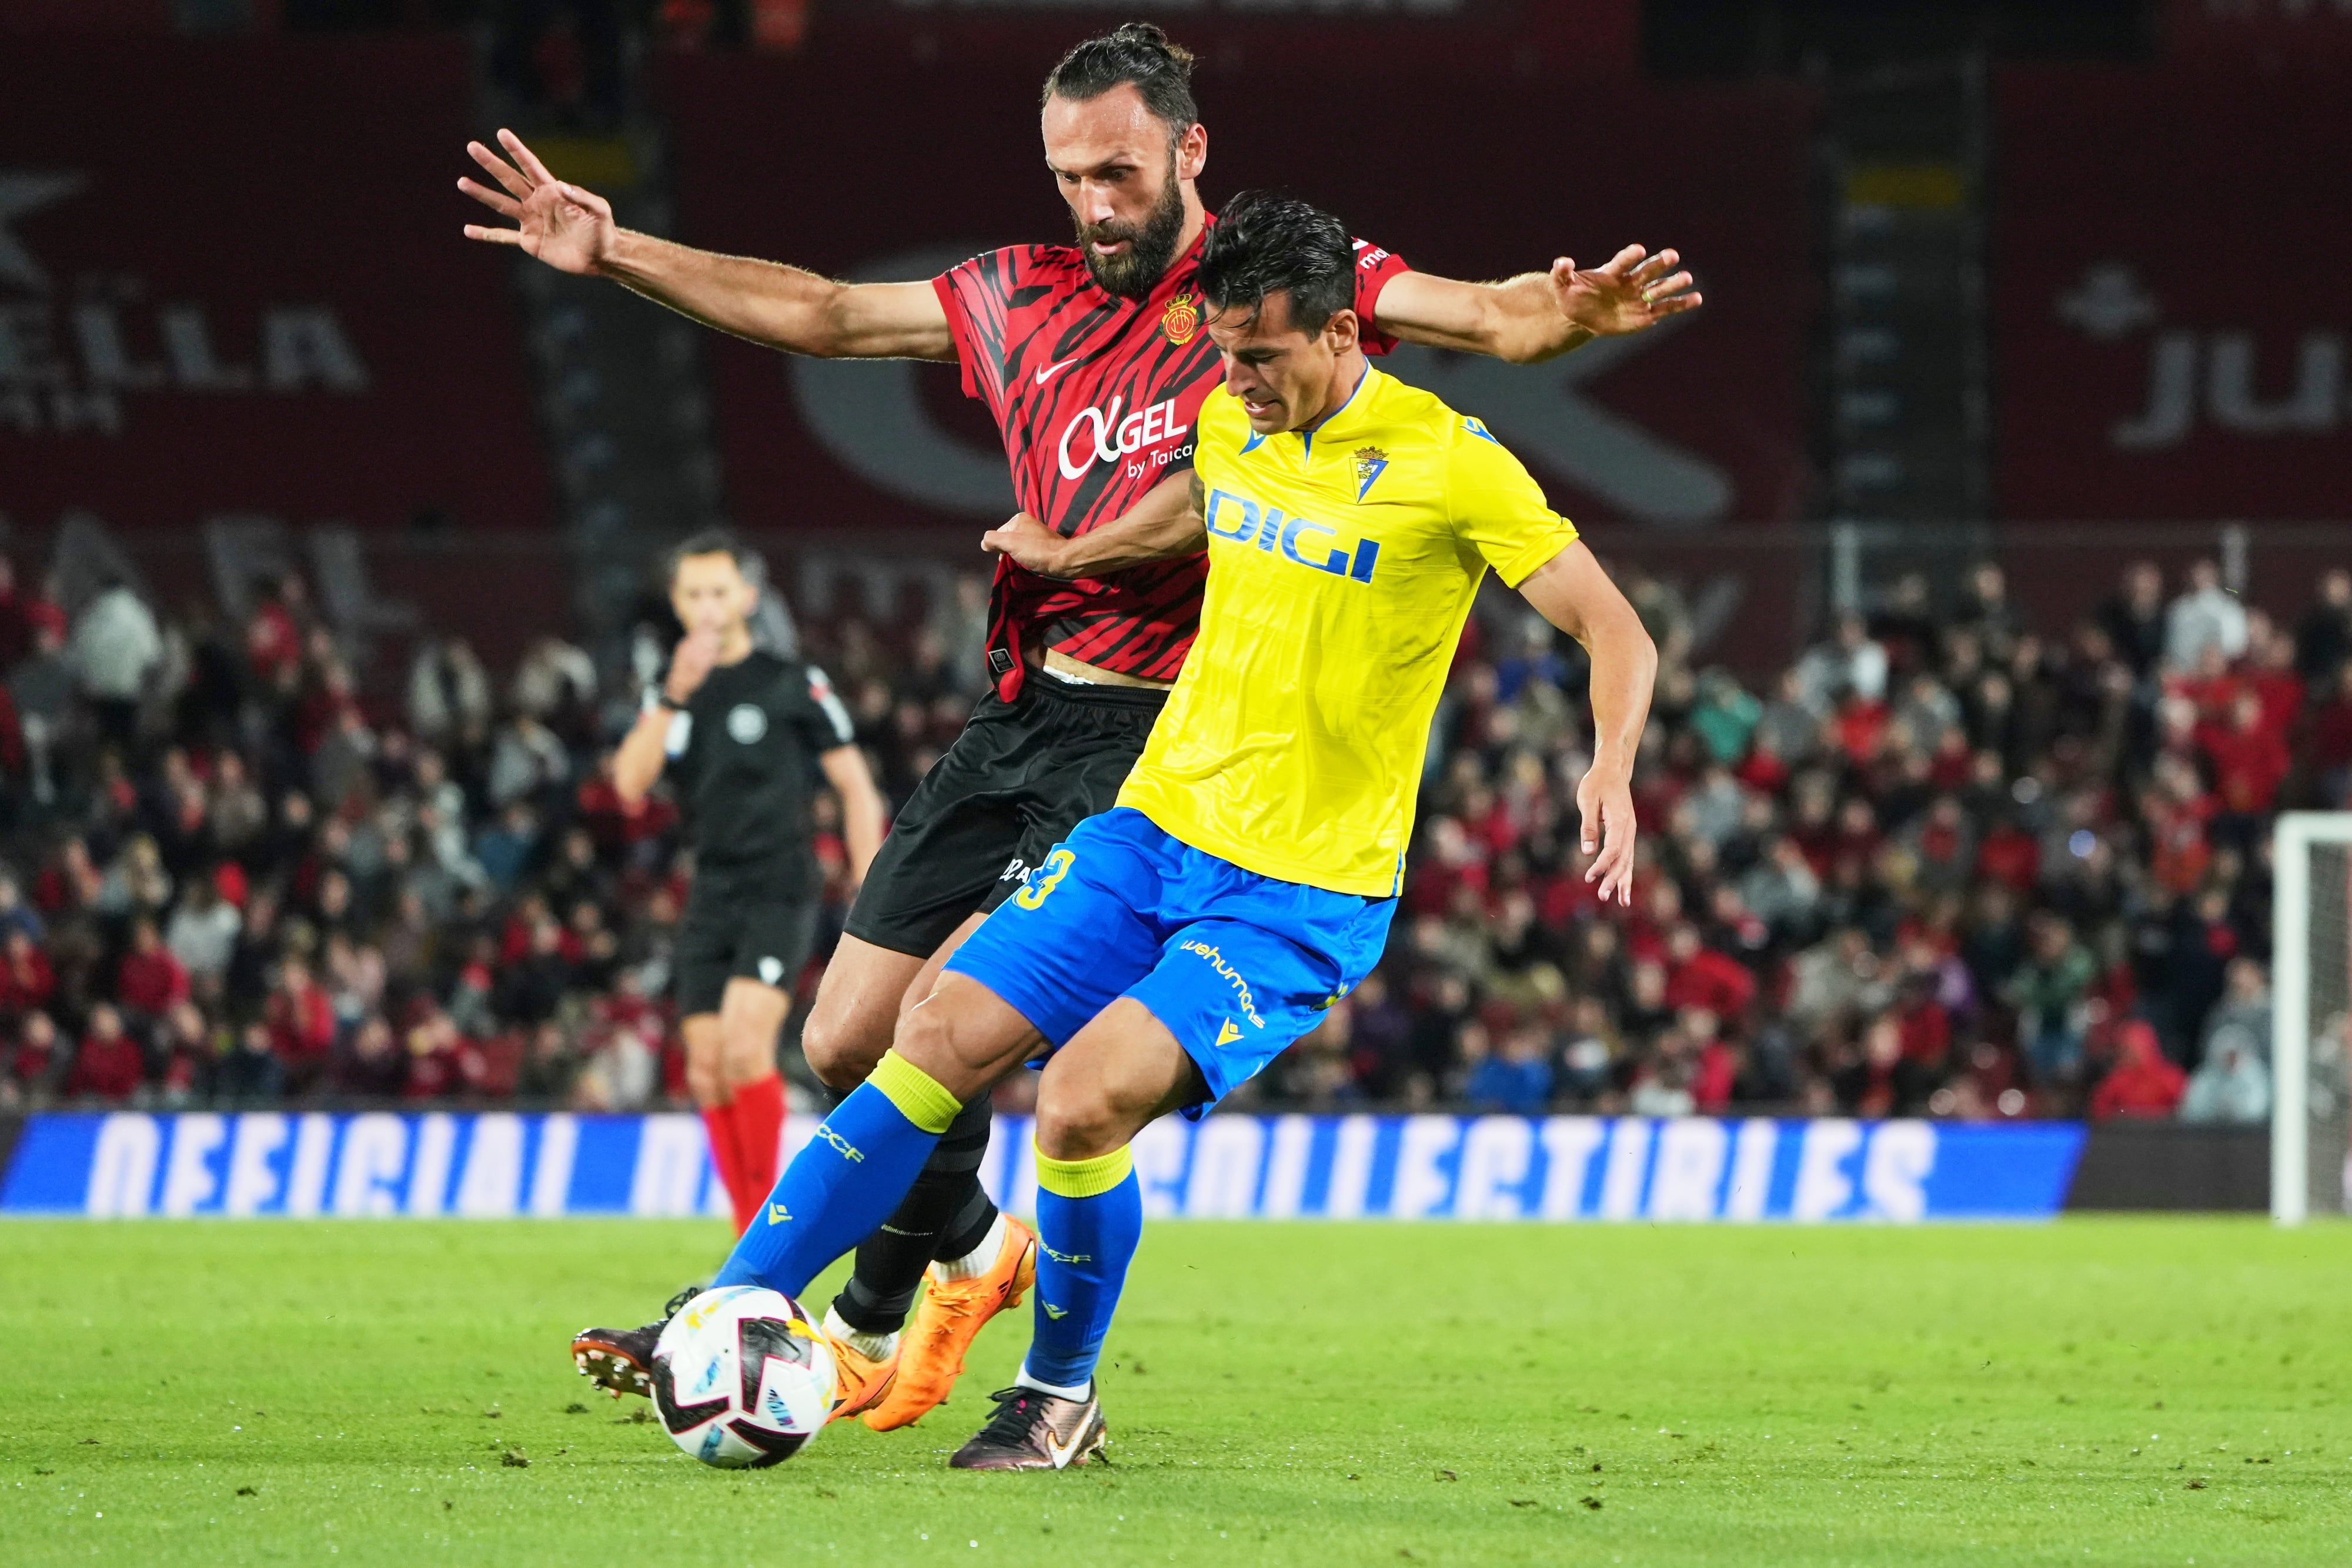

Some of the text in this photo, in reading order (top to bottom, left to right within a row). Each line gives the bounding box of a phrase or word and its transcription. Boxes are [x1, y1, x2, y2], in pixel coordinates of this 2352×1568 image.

[1127, 444, 1192, 479] by Taica
[1207, 489, 1380, 584] DIGI
